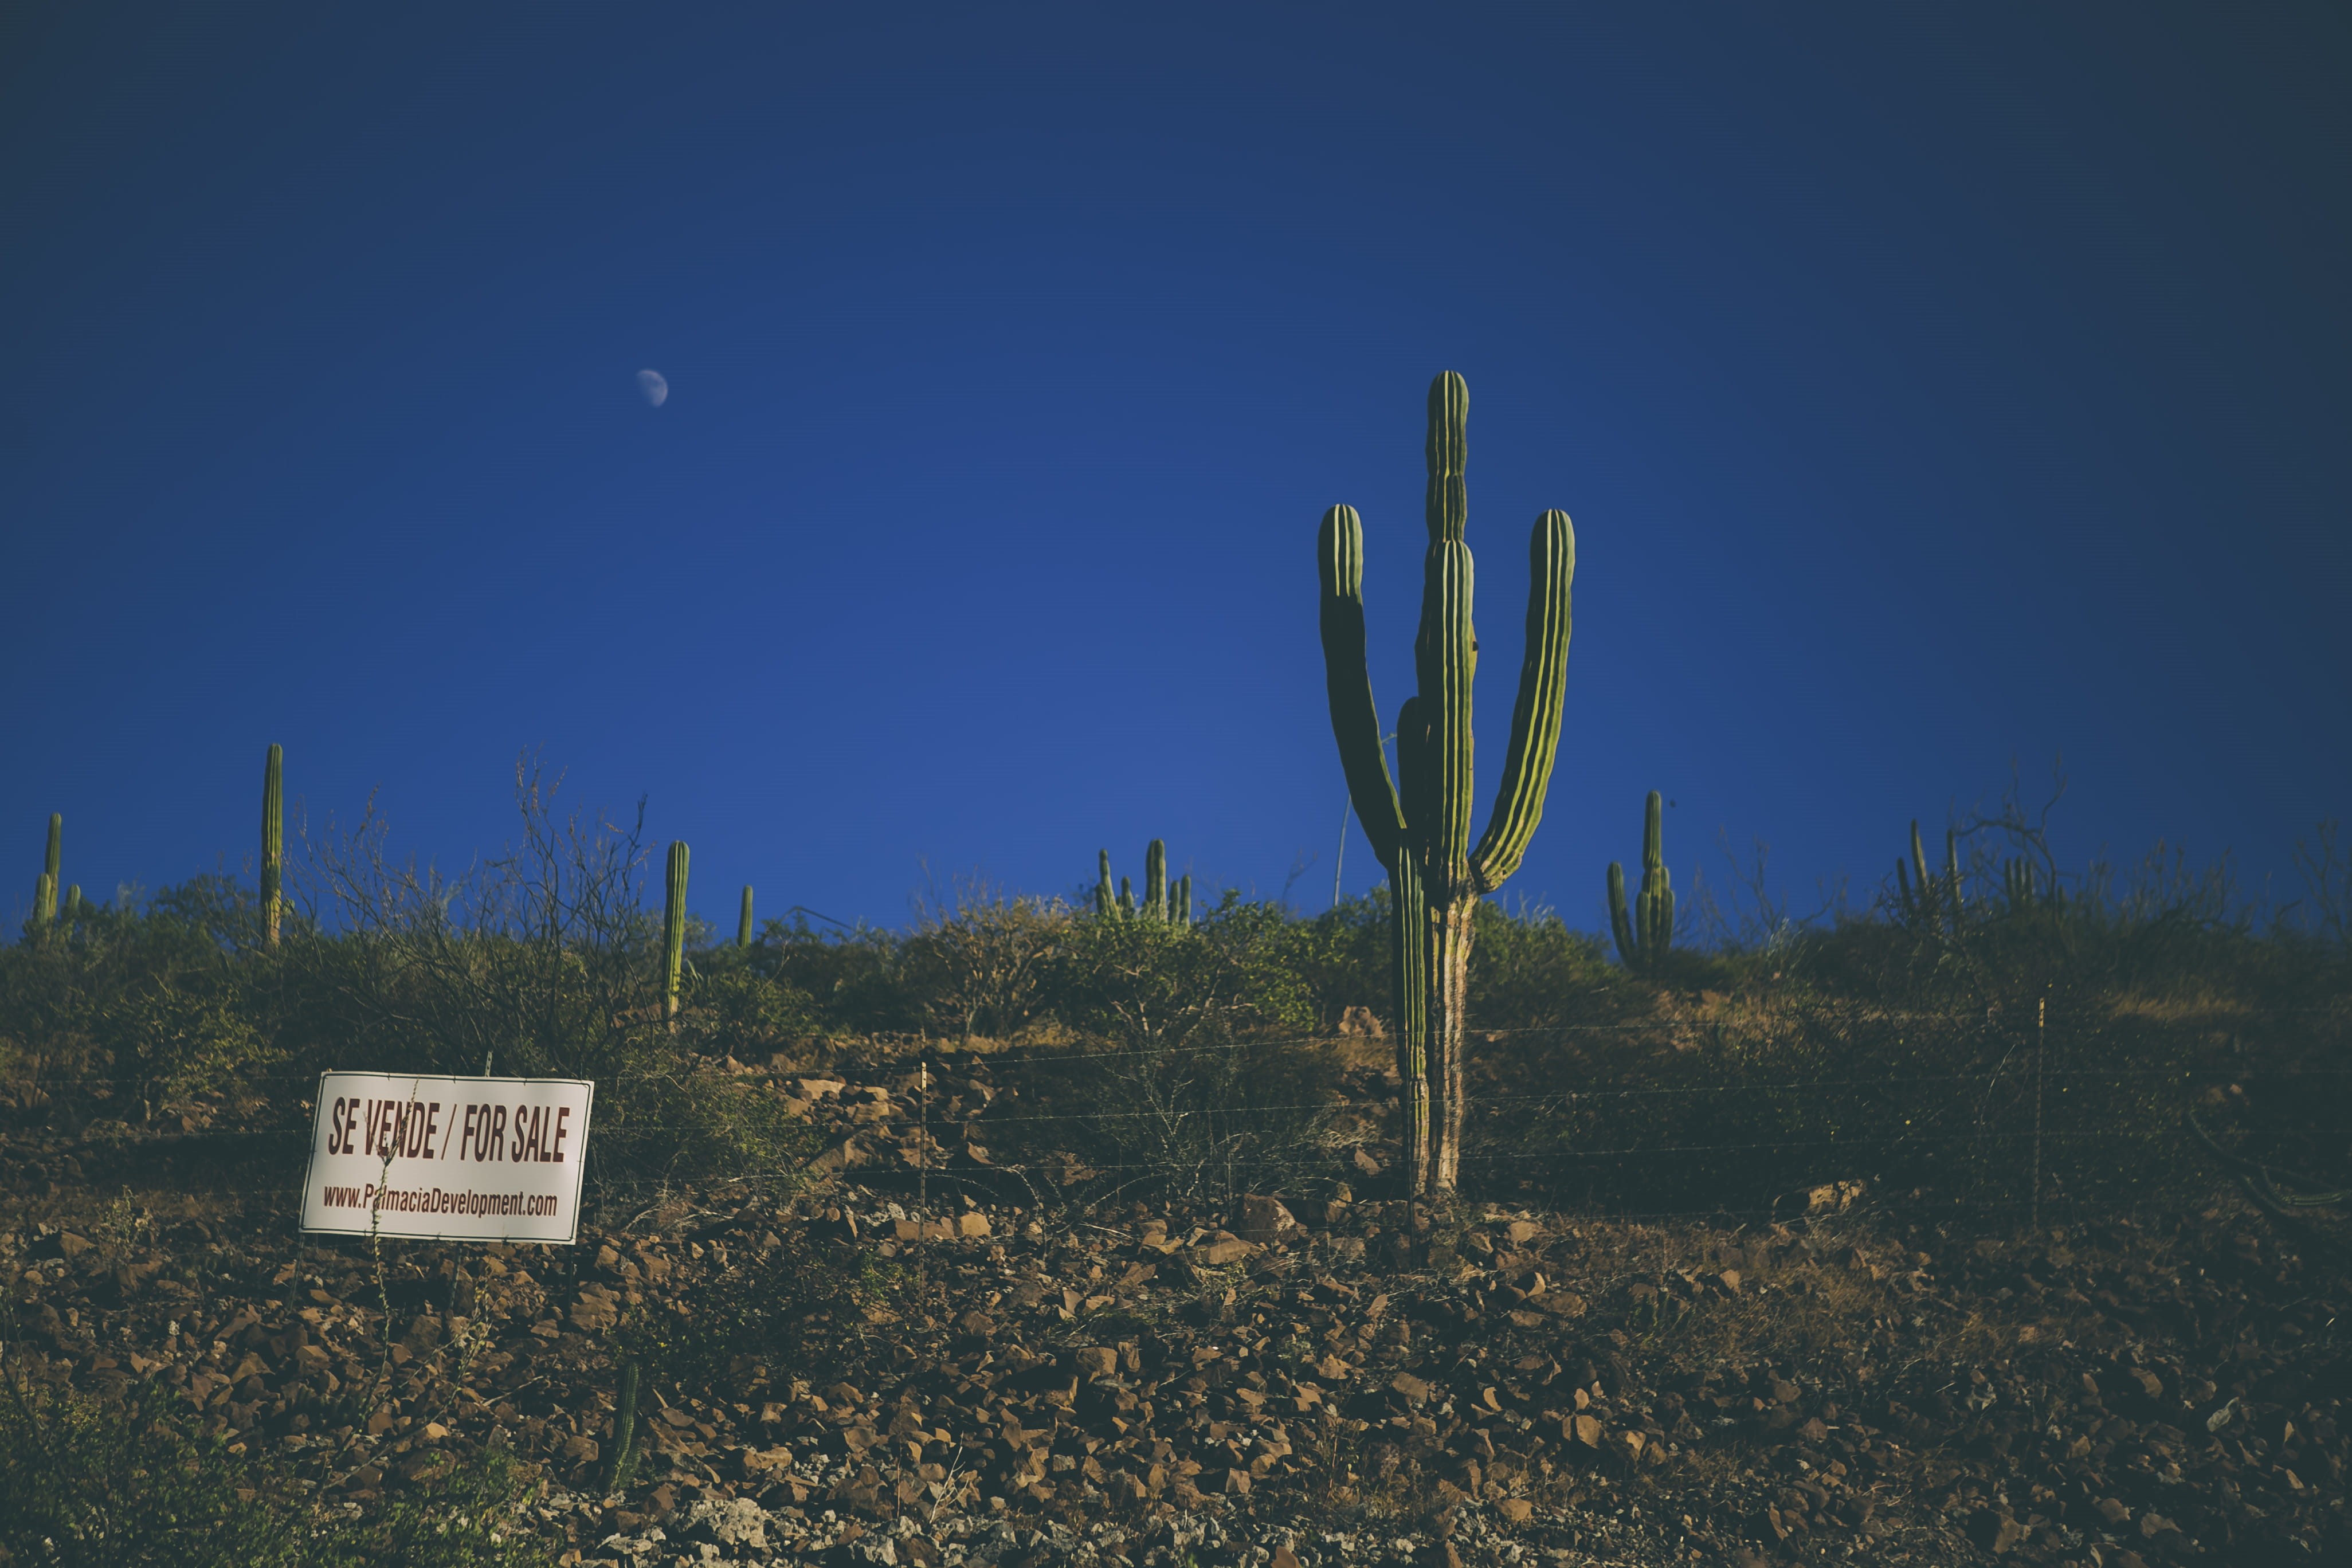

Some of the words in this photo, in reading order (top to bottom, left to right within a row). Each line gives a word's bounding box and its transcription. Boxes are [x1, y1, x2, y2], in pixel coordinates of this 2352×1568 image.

[328, 1096, 360, 1155] SE
[365, 1099, 440, 1159] VENDE
[441, 1103, 457, 1161] /
[460, 1103, 507, 1162] FOR
[511, 1104, 570, 1163] SALE
